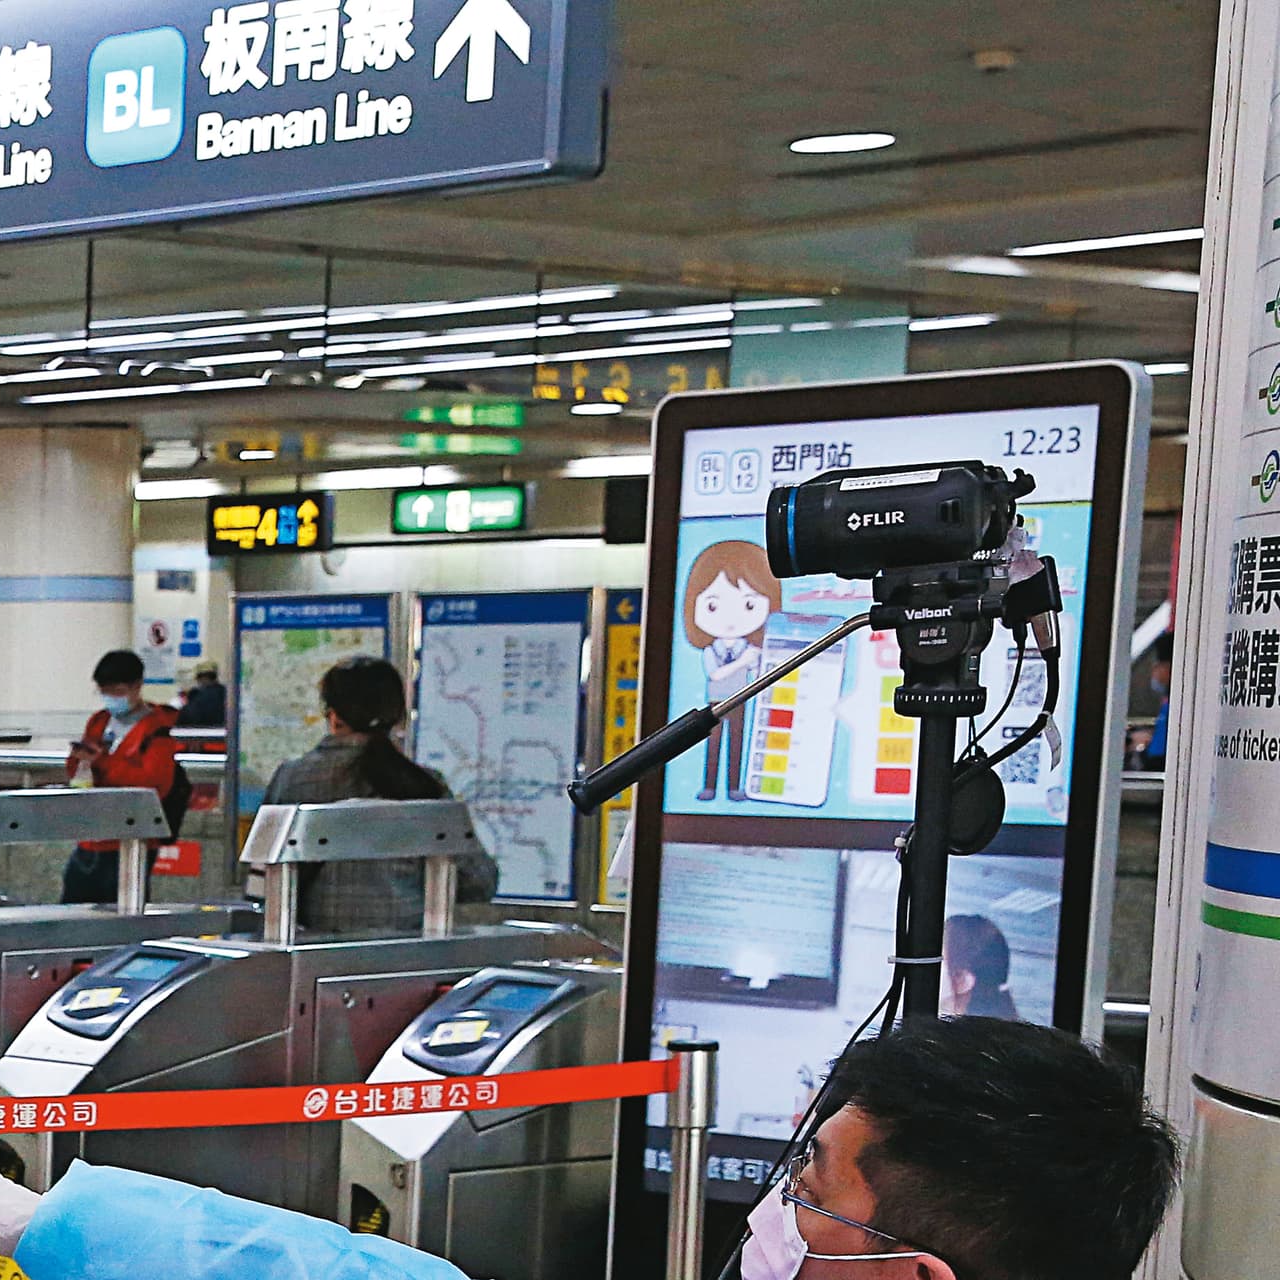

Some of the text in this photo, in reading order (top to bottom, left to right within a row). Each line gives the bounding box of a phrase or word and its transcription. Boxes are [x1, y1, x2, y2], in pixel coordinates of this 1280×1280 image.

[200, 0, 416, 96] 板南線
[102, 65, 171, 133] BL
[195, 89, 414, 162] Bannan Line
[771, 441, 853, 472] 西門站
[1003, 426, 1083, 458] 12:23
[700, 457, 721, 473] BL
[738, 454, 752, 471] G
[736, 473, 754, 488] 12
[863, 510, 905, 527] FLIR
[904, 606, 952, 621] Velbon
[1229, 729, 1242, 760] of
[334, 1080, 500, 1116] 台北捷運公司
